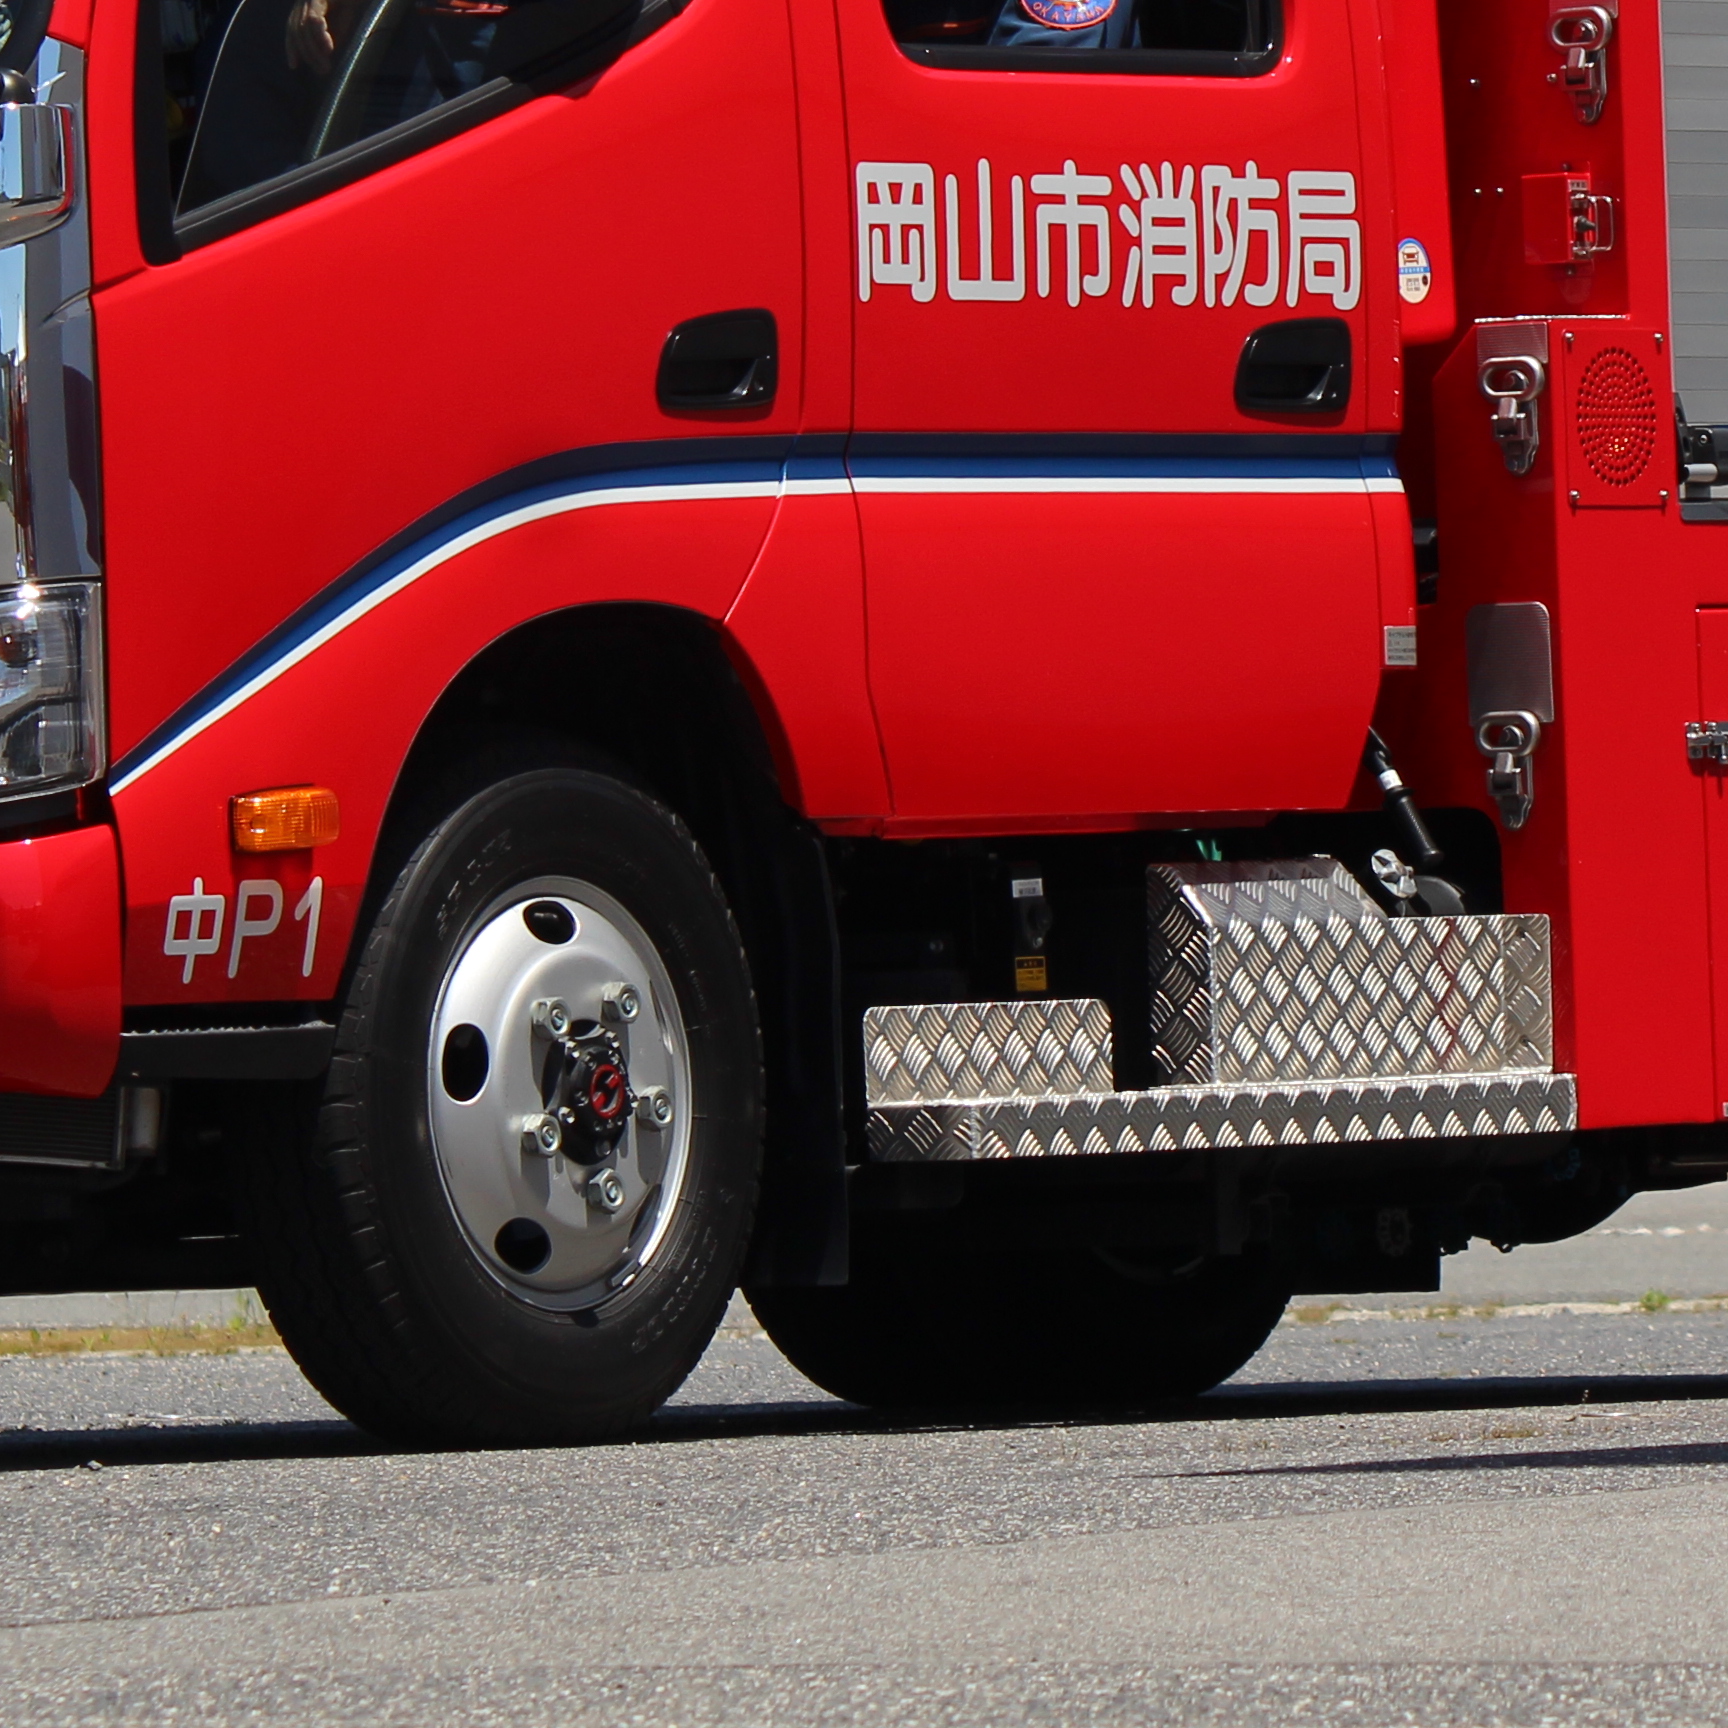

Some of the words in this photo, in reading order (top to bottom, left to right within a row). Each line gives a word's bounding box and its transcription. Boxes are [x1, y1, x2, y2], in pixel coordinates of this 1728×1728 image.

[855, 158, 1361, 311] 岡山市消防局
[164, 876, 323, 984] 中P1
